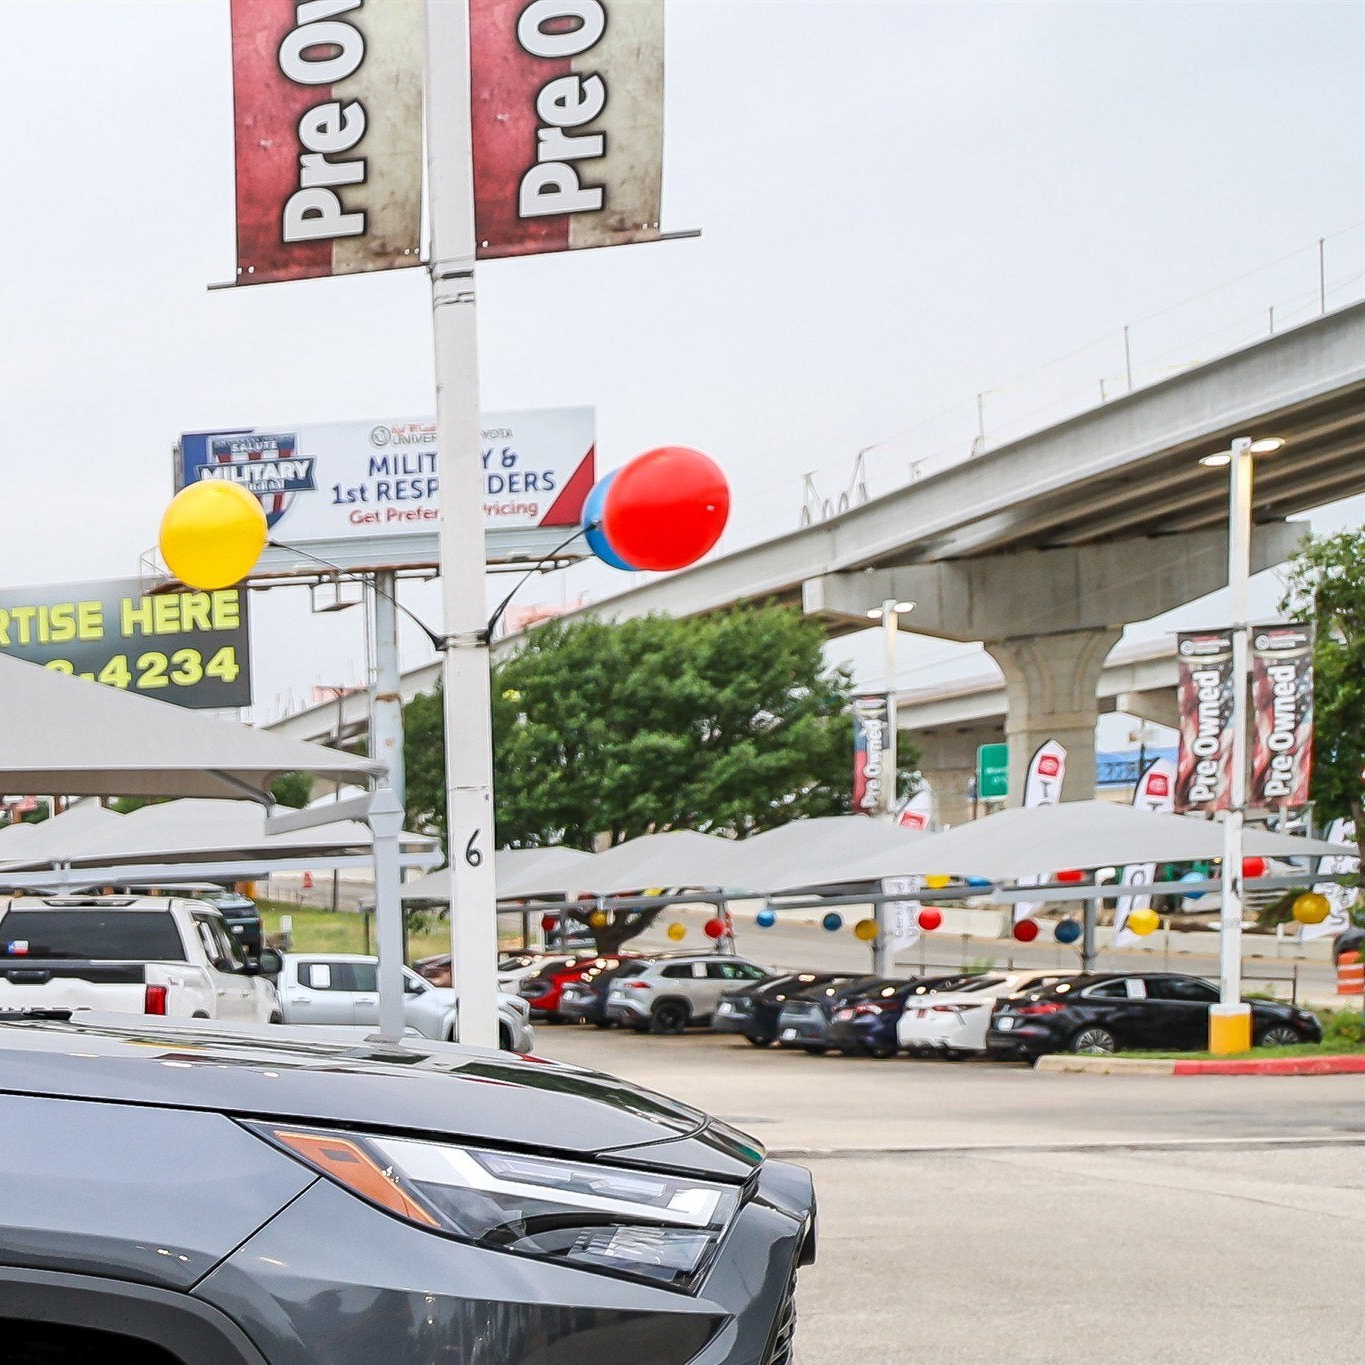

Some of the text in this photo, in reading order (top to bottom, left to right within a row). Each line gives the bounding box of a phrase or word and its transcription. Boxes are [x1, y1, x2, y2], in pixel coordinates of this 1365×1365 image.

[519, 72, 606, 218] Pre
[284, 100, 367, 243] Pre
[199, 459, 310, 482] MILITARY
[369, 446, 517, 477] MILITY &
[332, 471, 556, 504] 1st RESPDERS
[349, 508, 381, 525] Get
[482, 501, 540, 518] ricing
[121, 589, 241, 638] HERE
[1192, 669, 1221, 757] Owned
[1267, 664, 1297, 752] Owned
[1188, 759, 1218, 802] Pre
[1264, 753, 1294, 797] Pre
[465, 828, 483, 868] 6
